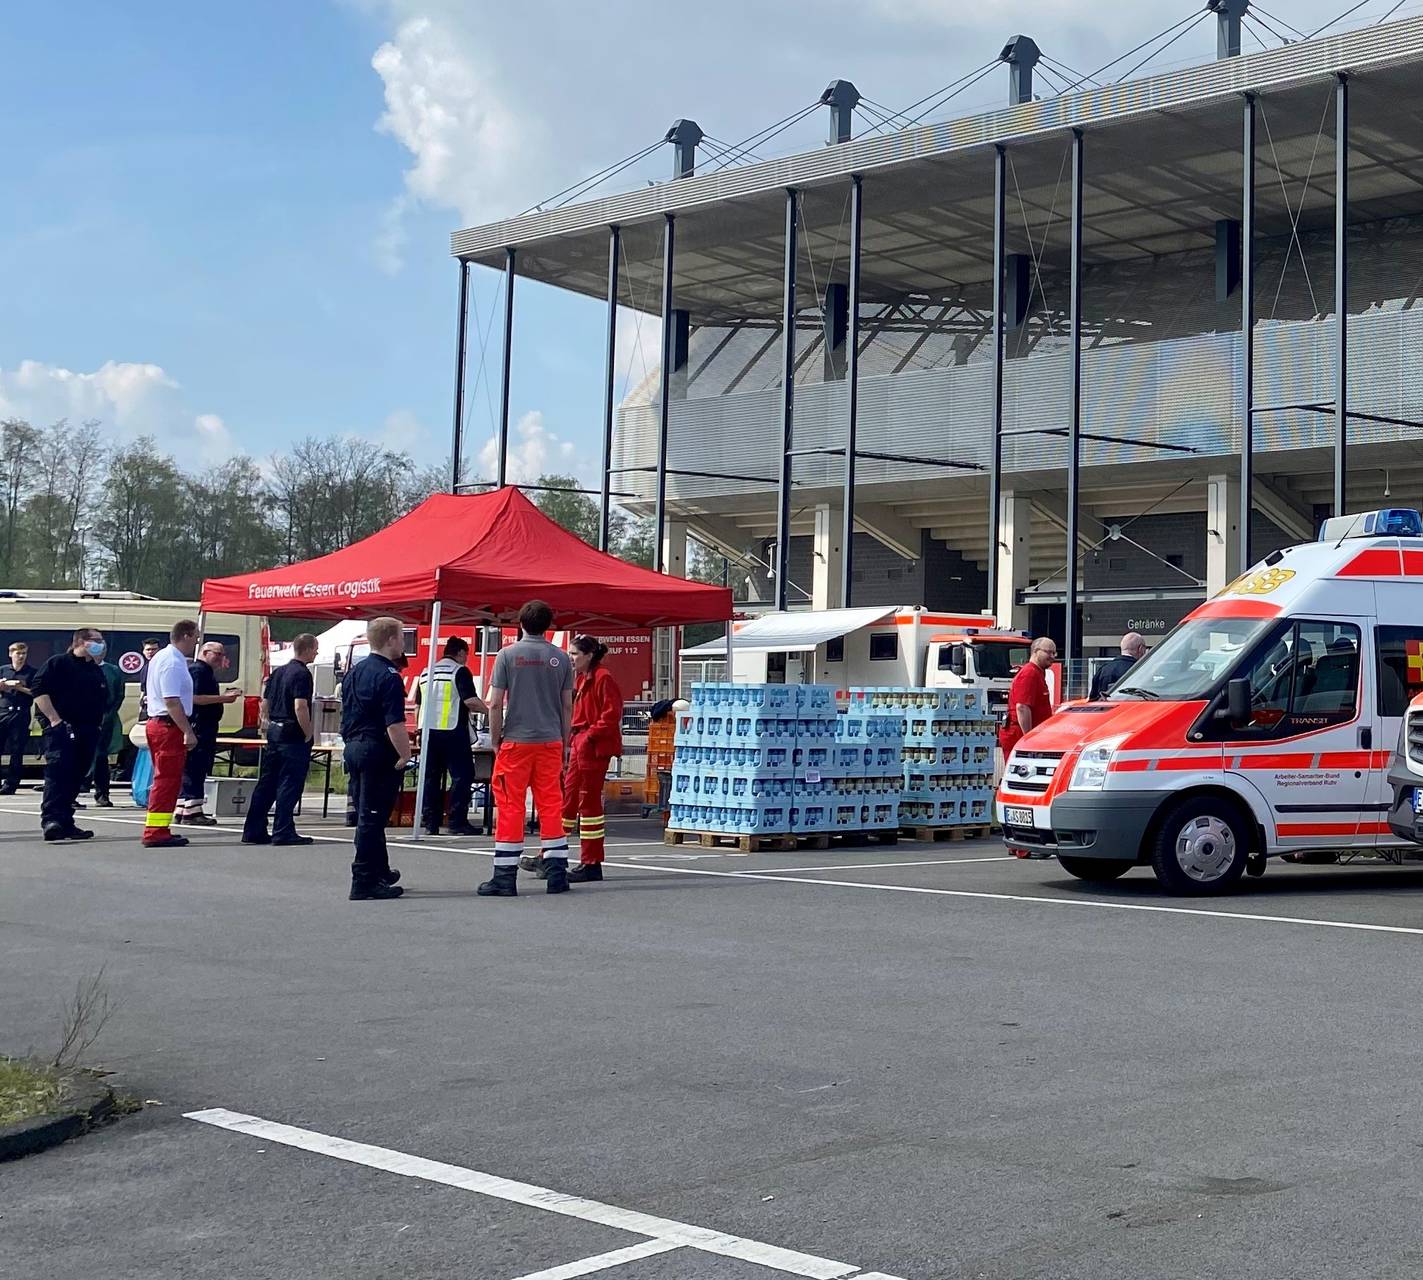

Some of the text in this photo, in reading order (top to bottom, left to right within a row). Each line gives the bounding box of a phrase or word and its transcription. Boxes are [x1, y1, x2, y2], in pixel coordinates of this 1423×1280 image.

[248, 577, 382, 599] Feuerwehr Essen Logistik
[1127, 618, 1165, 630] Getränke
